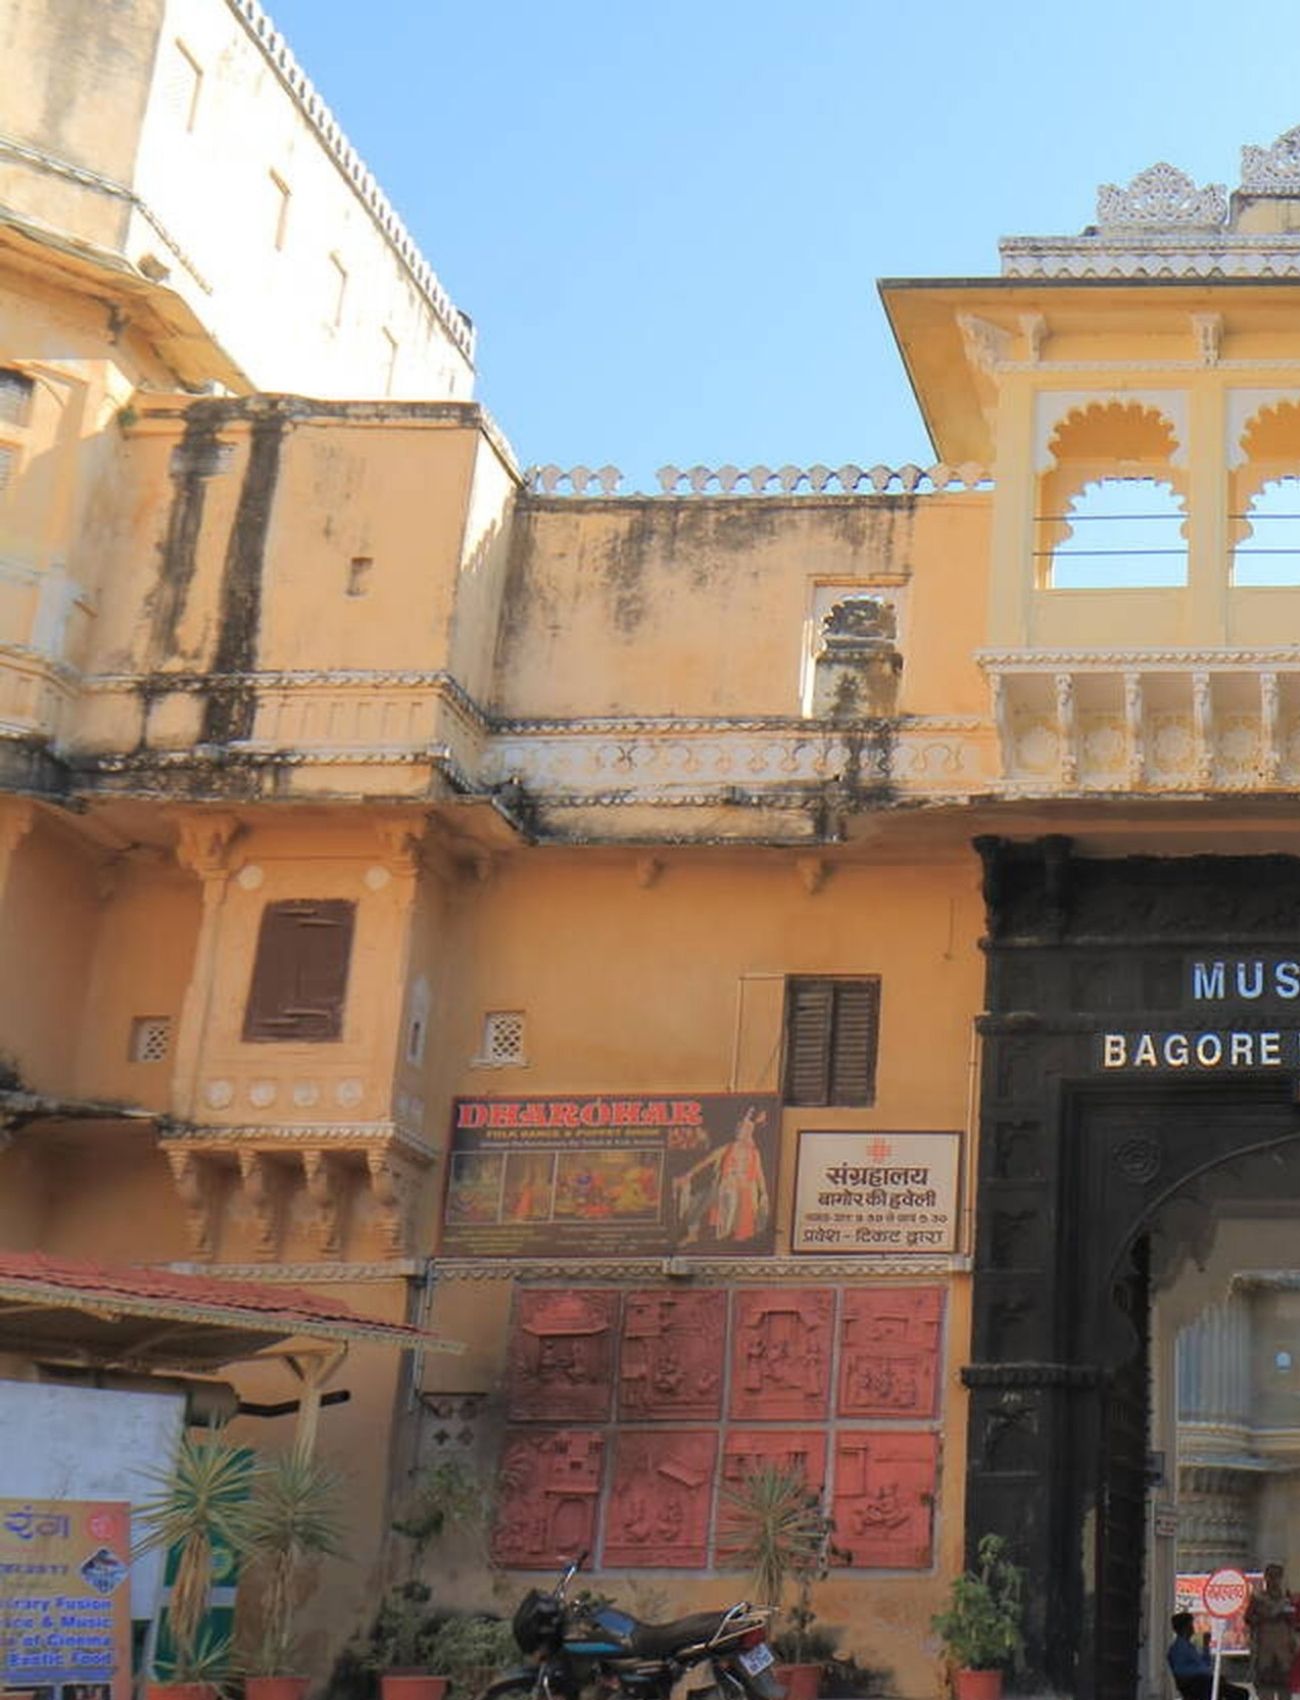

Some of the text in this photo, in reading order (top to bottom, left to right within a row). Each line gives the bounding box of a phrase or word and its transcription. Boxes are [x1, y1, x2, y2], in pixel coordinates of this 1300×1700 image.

[1103, 1032, 1283, 1069] BAGORE
[456, 1100, 704, 1129] DHAROHAR
[825, 1162, 929, 1187] संग्रहालय
[818, 1188, 937, 1209] बागोर की हवेली
[802, 1226, 840, 1243] प्रवेश
[855, 1226, 901, 1243] टिकट
[905, 1229, 943, 1246] द्वारा
[56, 1597, 112, 1610] Fusion
[61, 1616, 112, 1628] Music
[47, 1633, 112, 1646] Cinema
